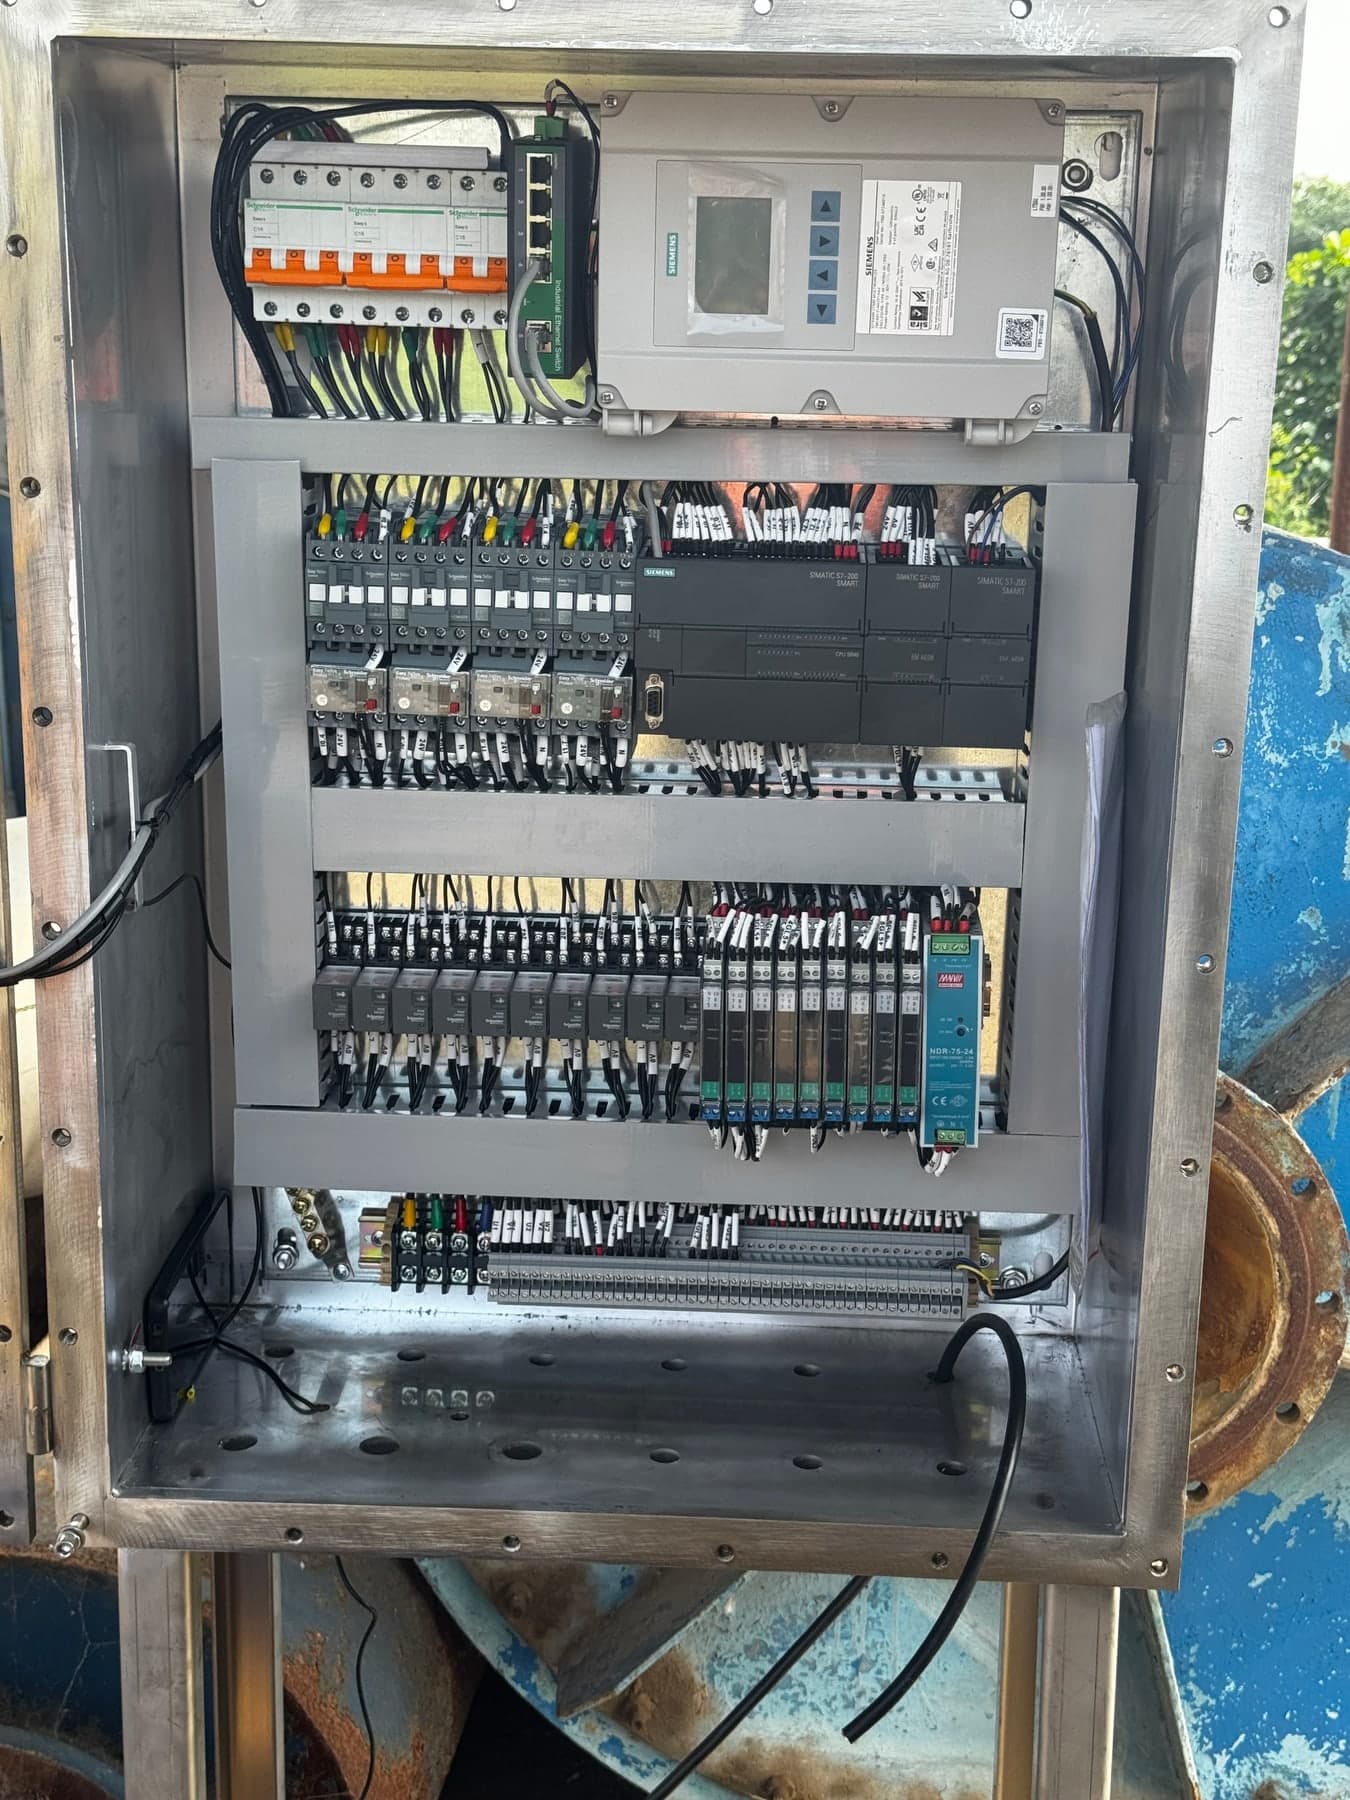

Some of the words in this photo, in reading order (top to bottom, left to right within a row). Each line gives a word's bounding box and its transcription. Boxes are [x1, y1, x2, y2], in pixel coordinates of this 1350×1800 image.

[246, 202, 275, 210] Schneider
[865, 236, 874, 276] SIEMENS
[371, 649, 380, 661] 24V
[453, 652, 463, 665] 24V
[535, 655, 543, 667] 24V
[616, 656, 625, 670] 24V
